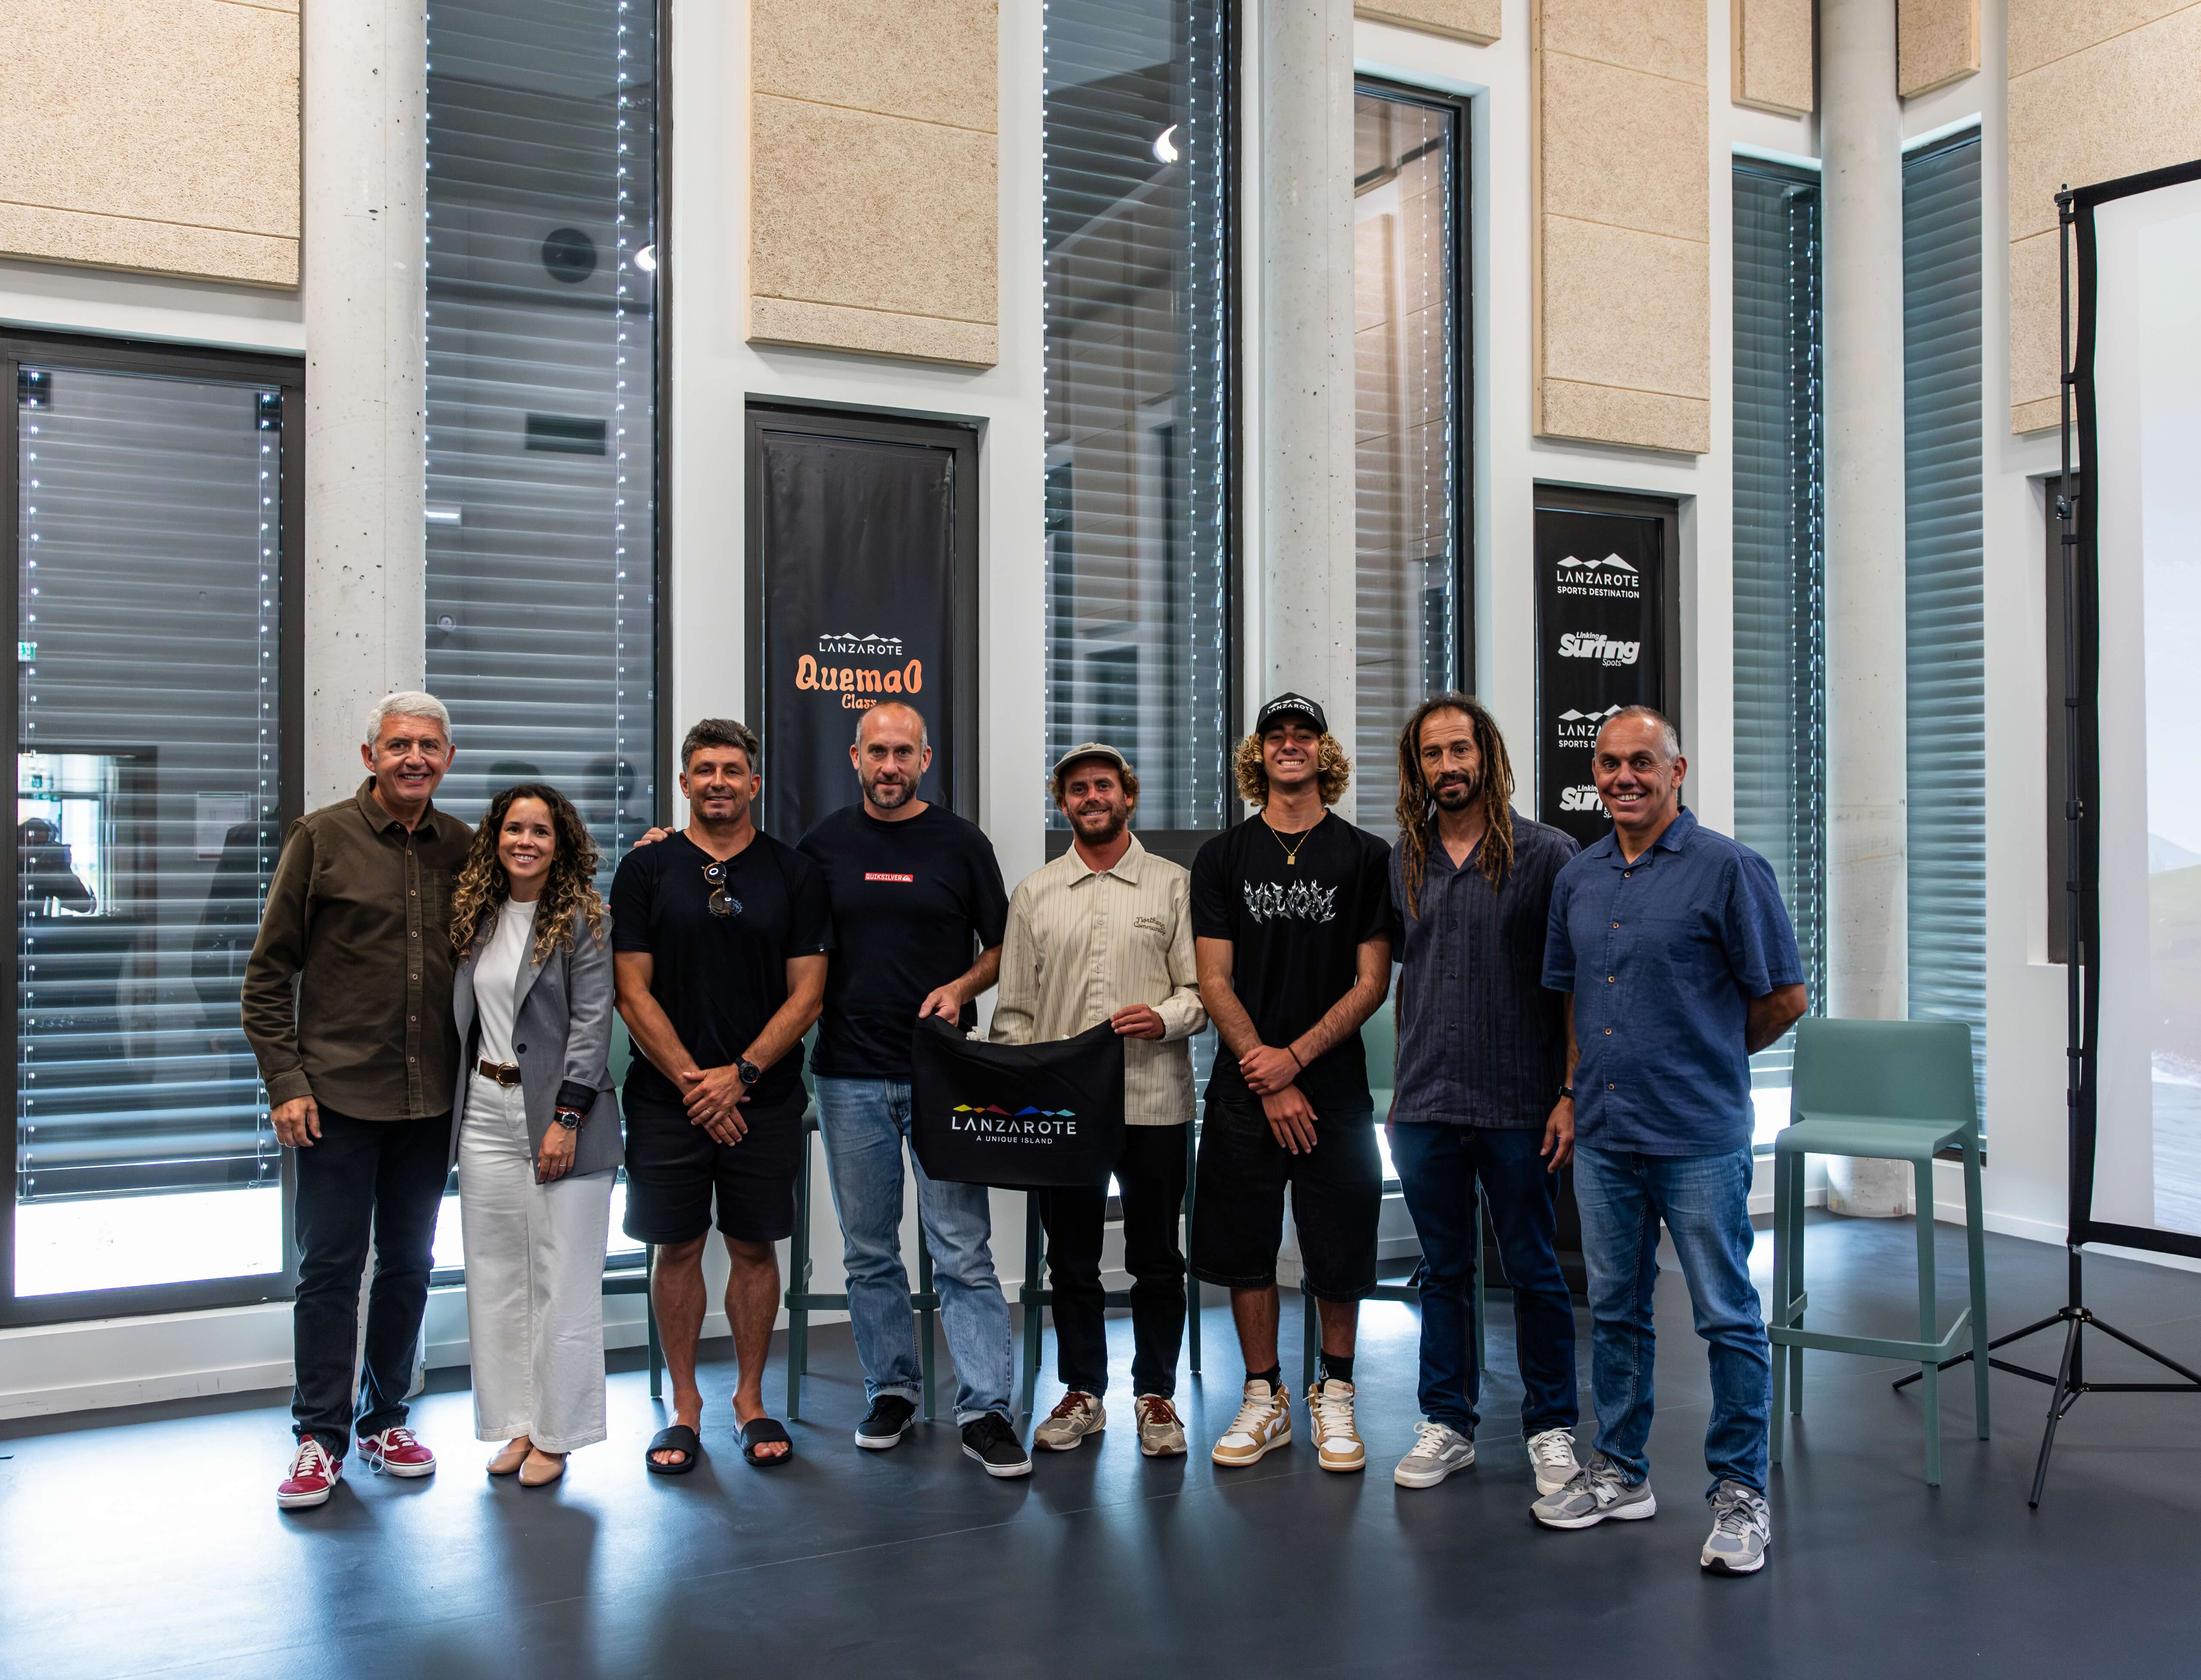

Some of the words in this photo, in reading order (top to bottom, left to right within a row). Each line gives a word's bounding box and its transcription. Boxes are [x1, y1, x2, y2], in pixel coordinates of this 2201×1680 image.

[1557, 570, 1638, 586] LANZAROTE
[1558, 586, 1586, 595] SPORTS
[1589, 588, 1639, 598] DESTINATION
[819, 643, 902, 655] LANZAROTE
[1558, 633, 1640, 664] Surfing
[1602, 658, 1622, 667] Spots
[1267, 704, 1314, 713] LANZAROTE
[1558, 724, 1601, 736] LANZA
[1134, 921, 1165, 936] Community
[1136, 916, 1165, 929] Northern
[952, 1116, 1077, 1135] LANZAROTE
